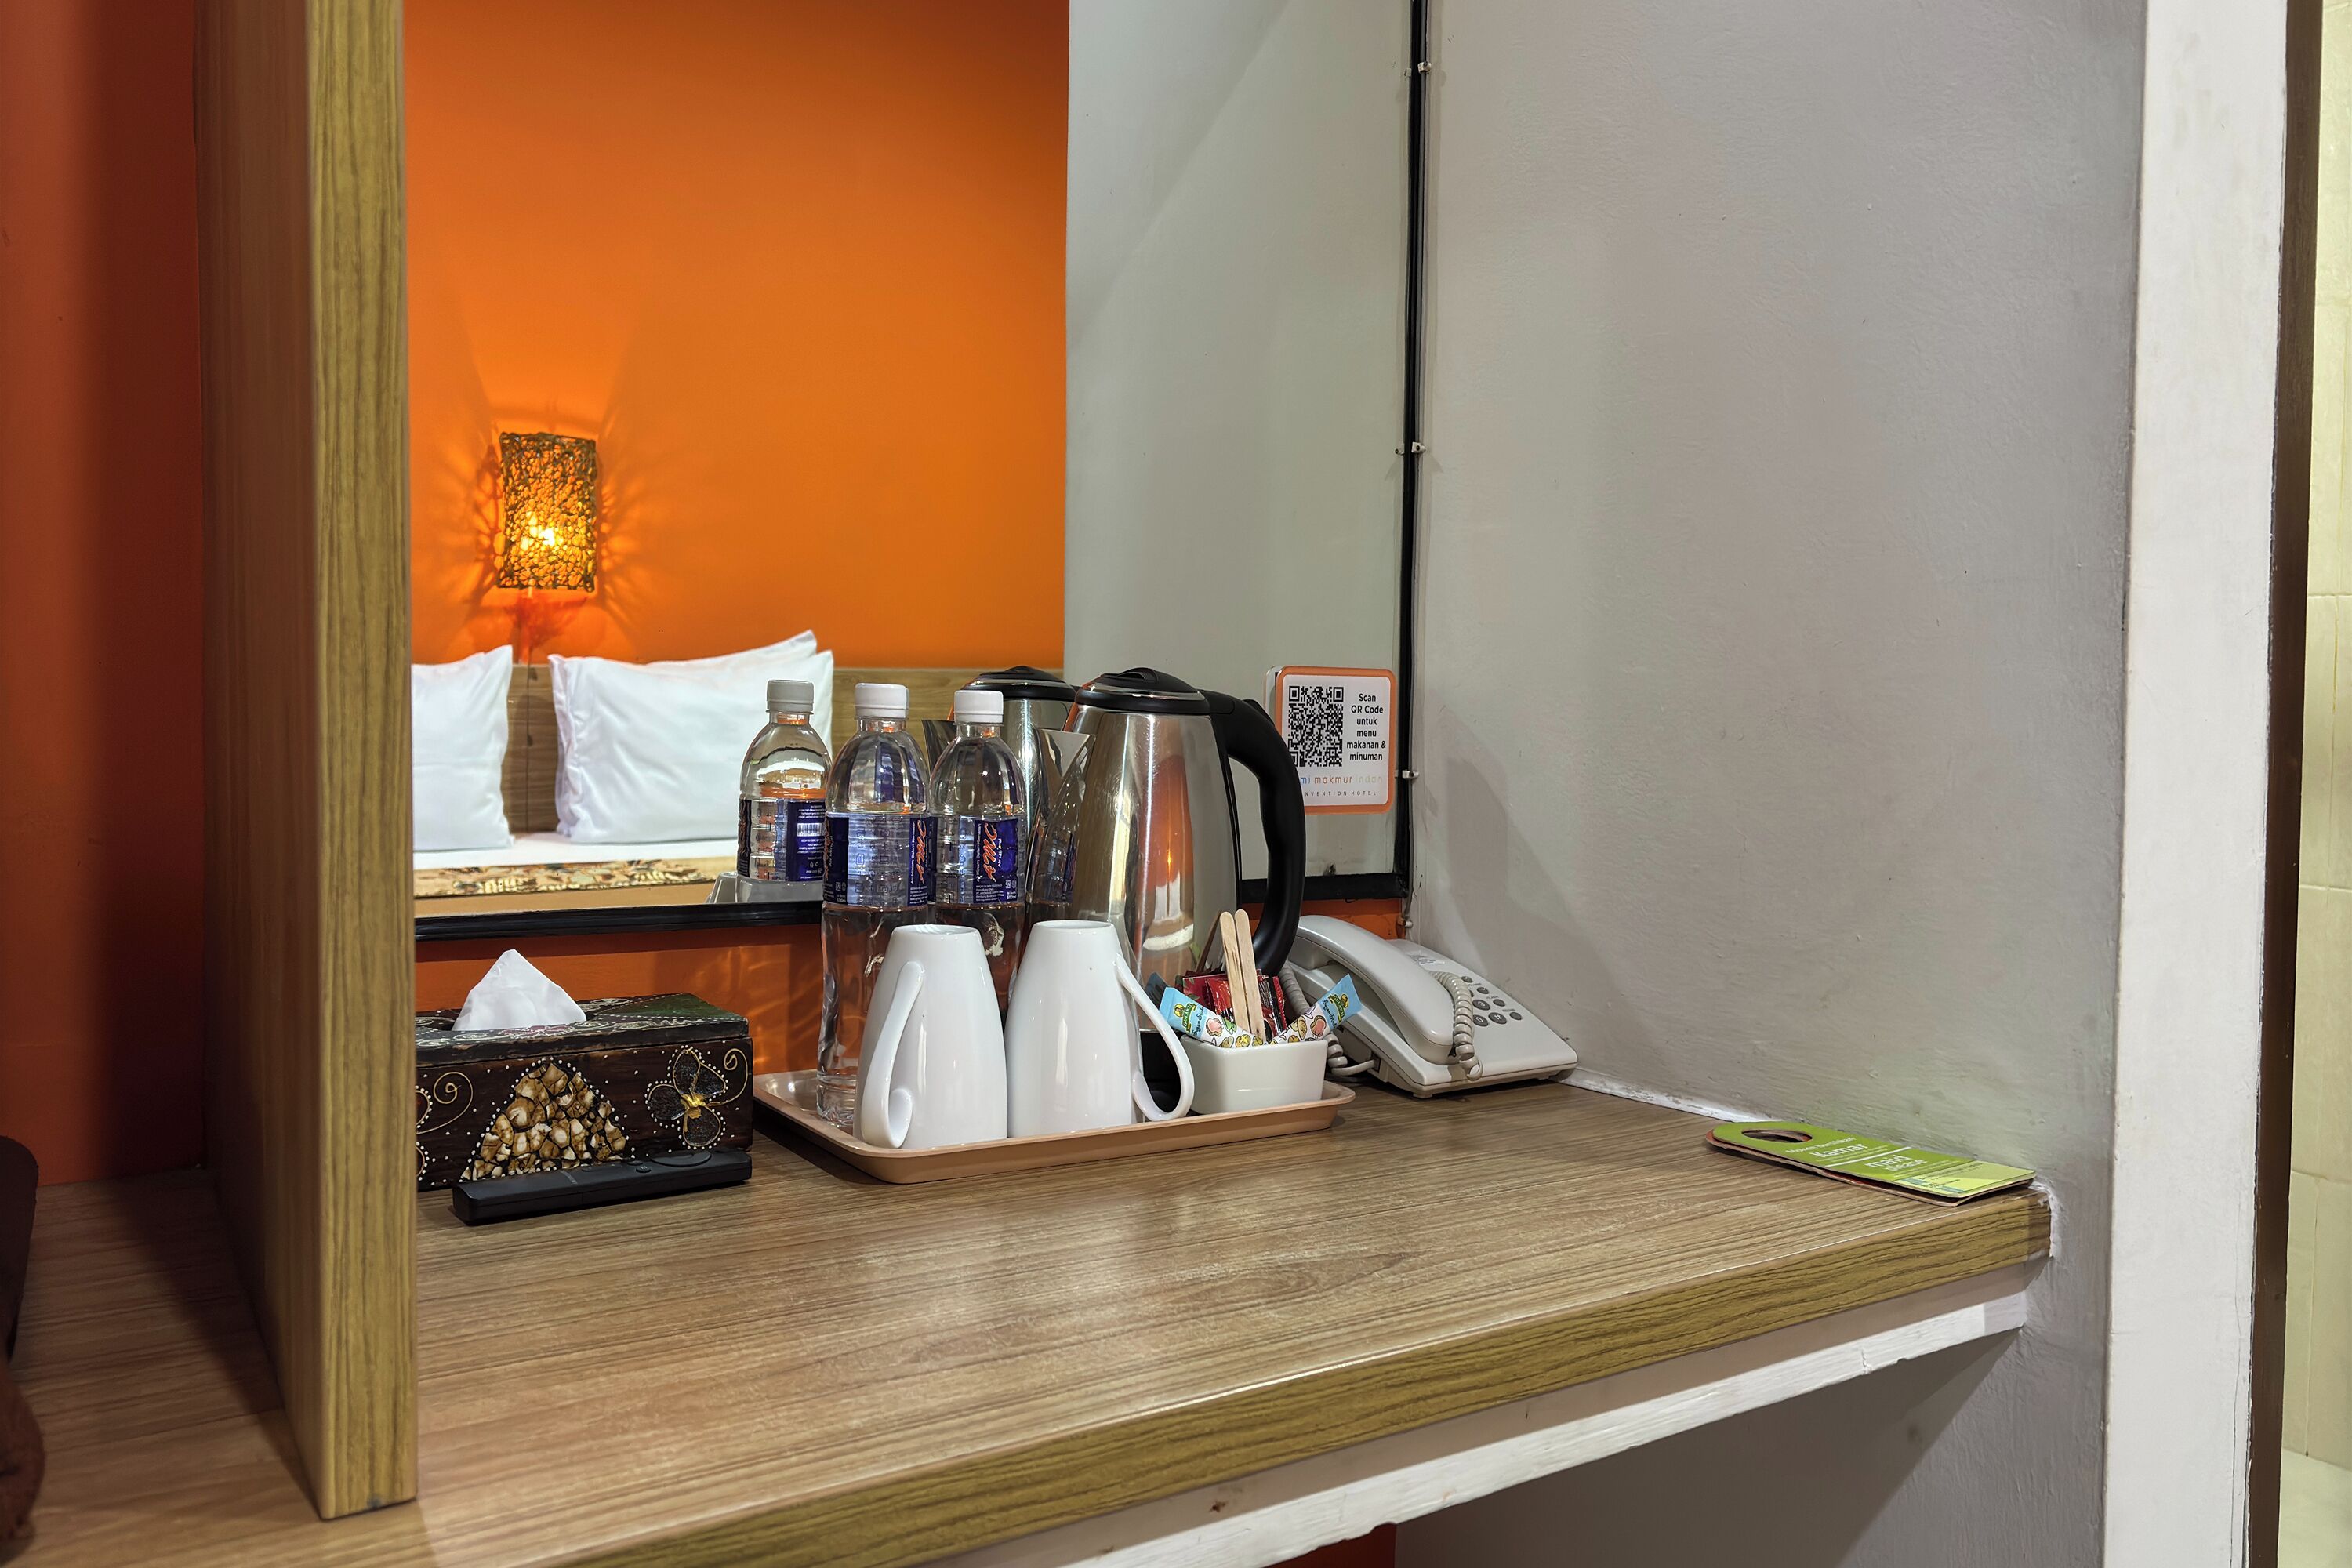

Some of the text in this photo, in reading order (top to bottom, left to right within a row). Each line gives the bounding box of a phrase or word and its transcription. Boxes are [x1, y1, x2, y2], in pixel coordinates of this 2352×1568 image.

[1359, 693, 1376, 702] Scan
[1351, 705, 1384, 714] QR Code
[1346, 741, 1379, 750] makanan
[1349, 752, 1383, 760] minuman
[1314, 775, 1352, 784] makmur
[1333, 994, 1345, 1017] GULAKU
[1183, 1003, 1192, 1028] GULAKU
[1864, 1154, 1913, 1168] maid
